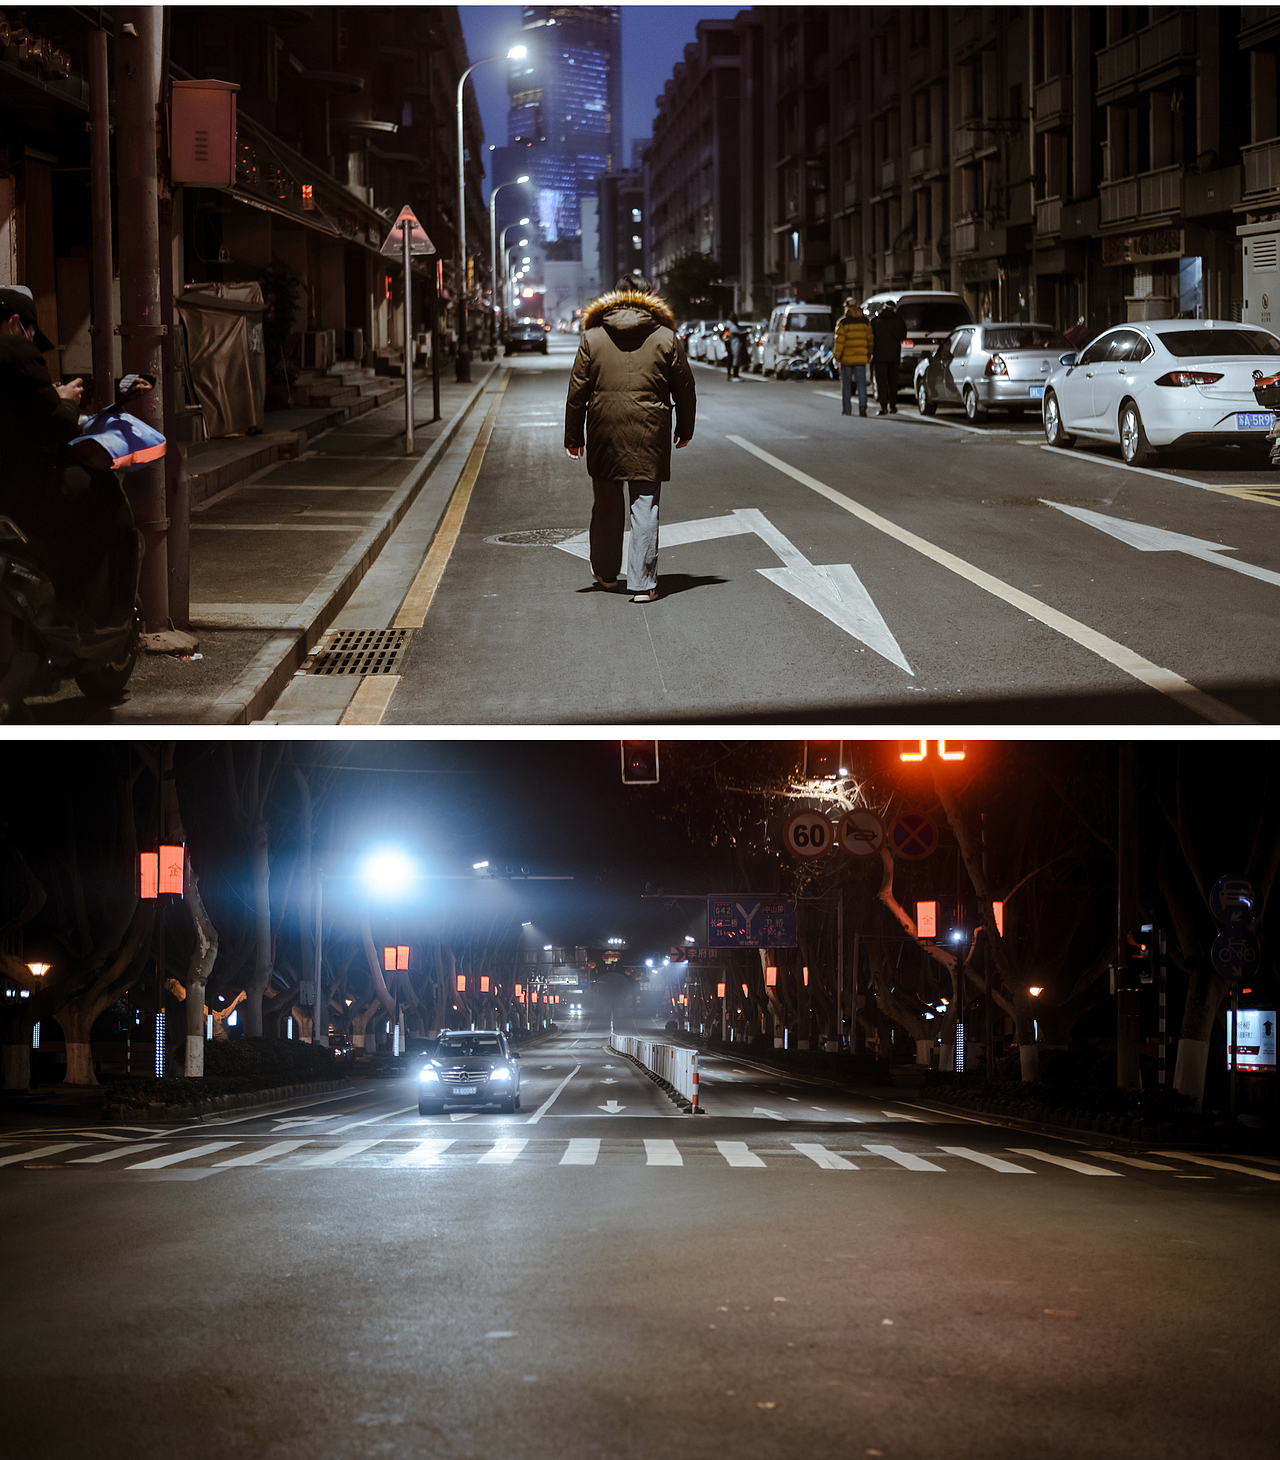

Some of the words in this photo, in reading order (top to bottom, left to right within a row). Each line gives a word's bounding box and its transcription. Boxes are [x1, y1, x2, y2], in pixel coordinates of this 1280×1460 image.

[793, 824, 825, 847] 60
[715, 906, 731, 915] G42
[710, 918, 738, 928] 长江二桥
[687, 948, 718, 959] 李府街
